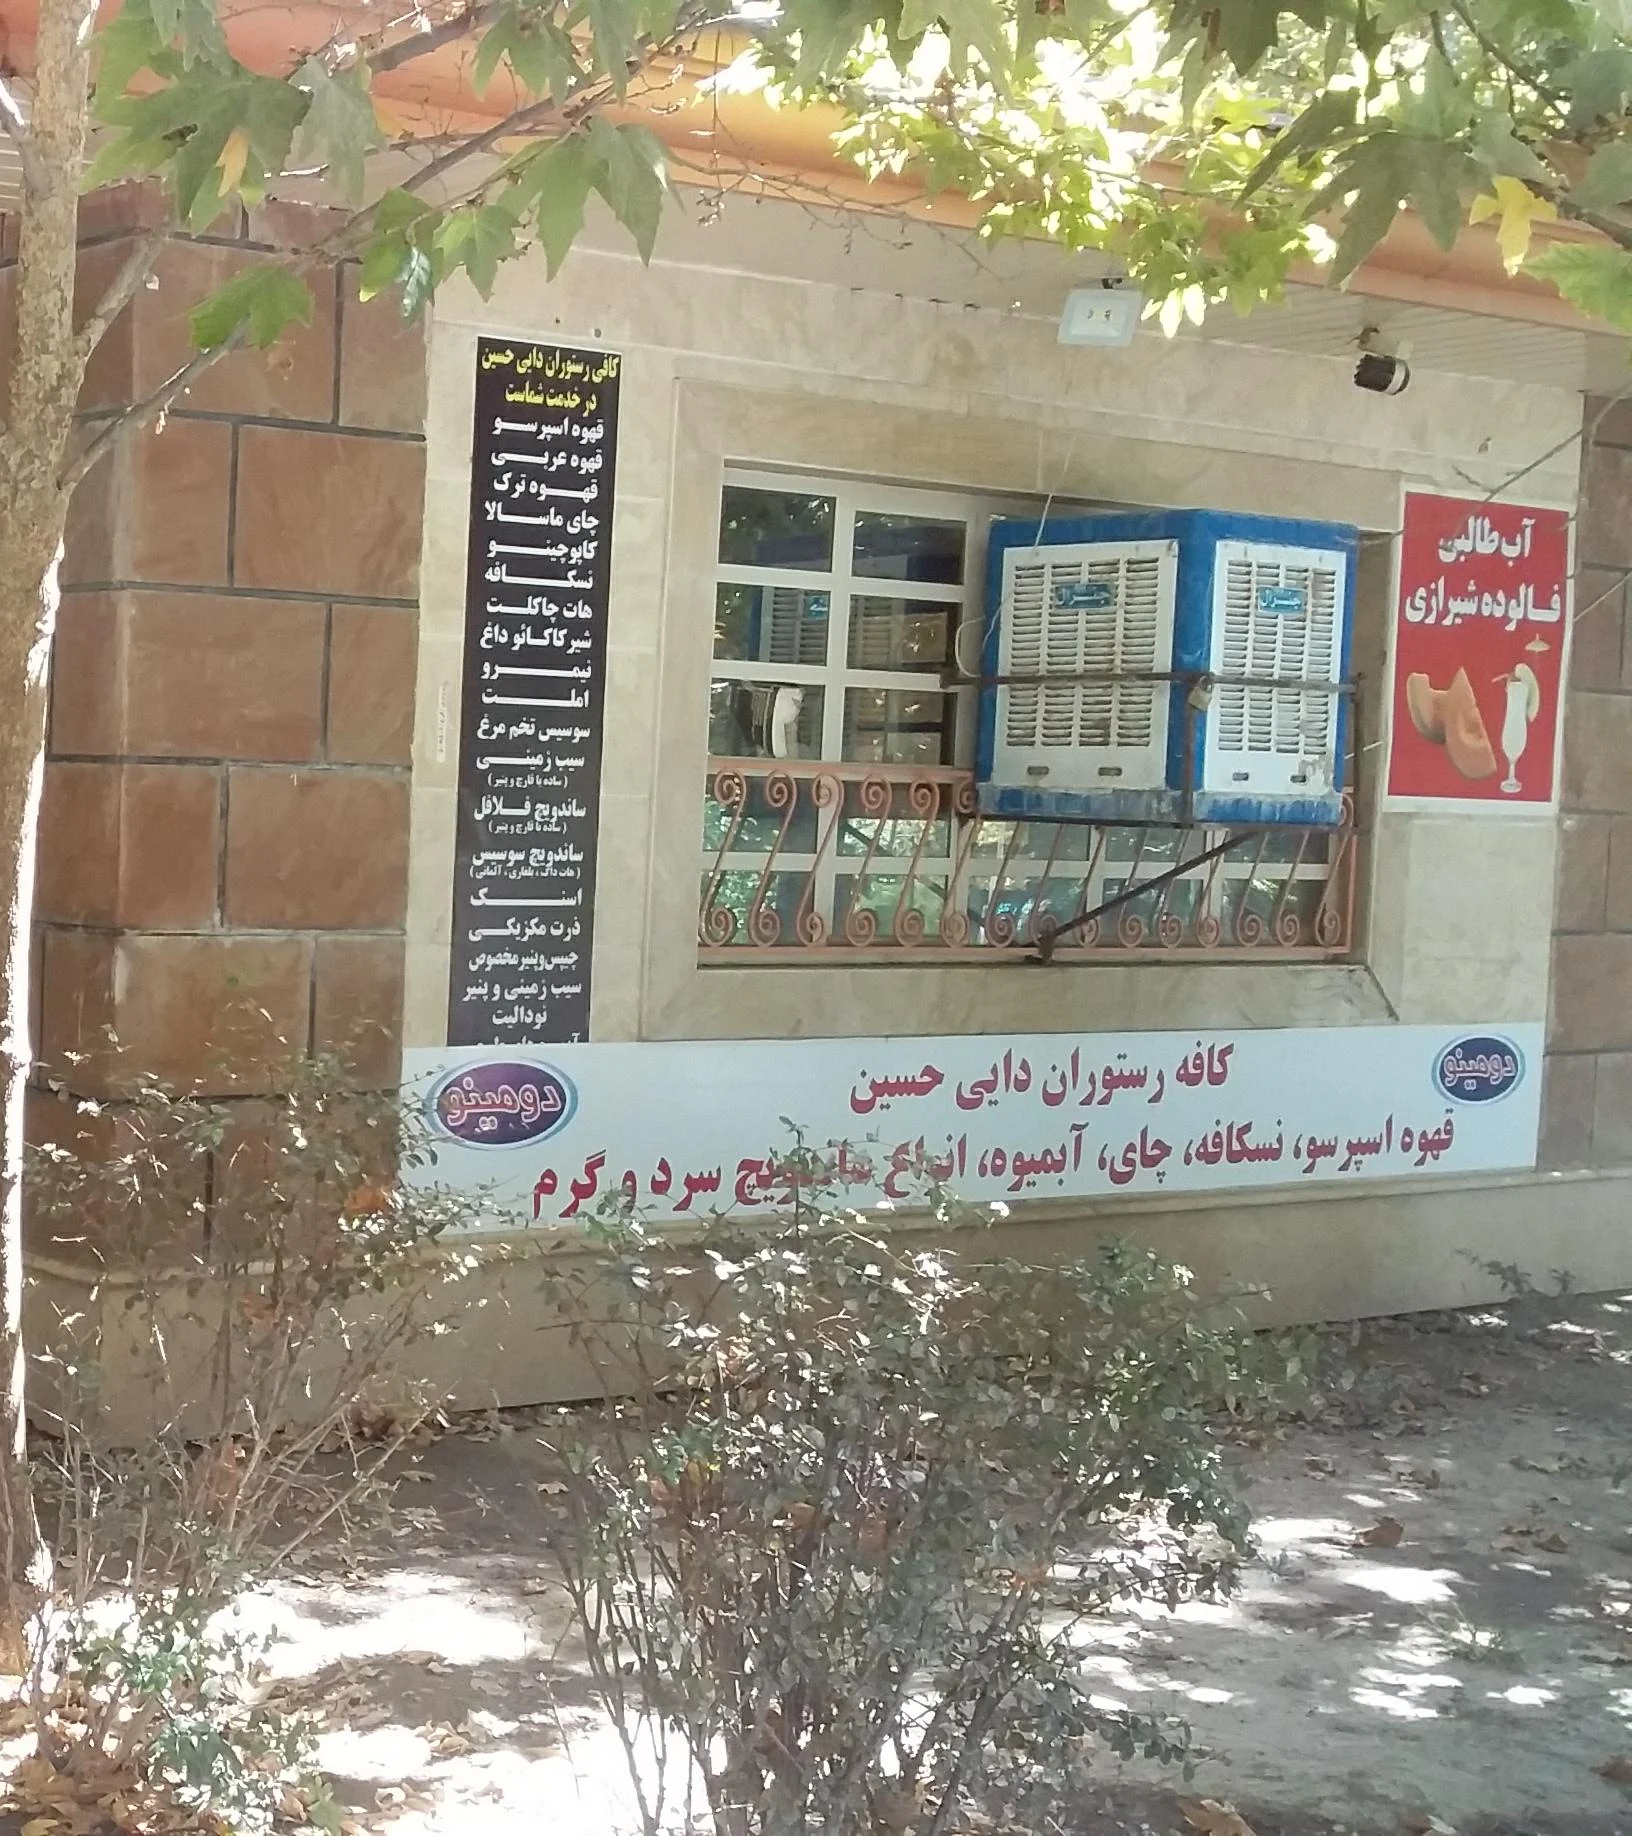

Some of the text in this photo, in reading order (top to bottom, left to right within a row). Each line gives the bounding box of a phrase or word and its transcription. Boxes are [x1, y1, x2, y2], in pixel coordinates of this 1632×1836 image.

[481, 347, 620, 383] کافی رستوران دایی حسین
[505, 381, 597, 417] در خدمت شماست
[571, 419, 604, 444] قهوه
[491, 449, 603, 474] قهوه عربی
[493, 472, 599, 503] قهوه ترک
[484, 501, 600, 536] چای ماسالا
[487, 539, 598, 565] کاپوچینو
[1438, 515, 1535, 567] آب طالبی
[484, 561, 593, 589] نسکافه
[486, 596, 593, 623] هات چاکلت
[1405, 575, 1561, 631] فالوده شیرازی
[479, 622, 592, 654] شیر کاکائو داغ
[480, 660, 592, 683] نیمرو
[481, 688, 590, 708] املت
[476, 714, 590, 743] سوسیس تخم مرغ
[476, 749, 585, 772] سیب زمینی
[515, 773, 534, 788] قارچ
[474, 795, 586, 822] ساندویچ فلافل
[472, 842, 584, 867] ساندویچ سوسیس
[470, 887, 583, 906] اسنک
[468, 916, 581, 942] ذرت مکزیکی
[468, 946, 519, 972] مخصوص
[518, 949, 539, 971] پنیر
[462, 978, 582, 1002] سیب زمینی و پنیر
[850, 1040, 1234, 1114] کافه رستوران دایی حسین
[1443, 1048, 1516, 1091] دومینو
[446, 1076, 563, 1131] دومینو
[1400, 1107, 1454, 1166] قهوه
[533, 1147, 607, 1219] گرم
[650, 1156, 722, 1212] سرد
